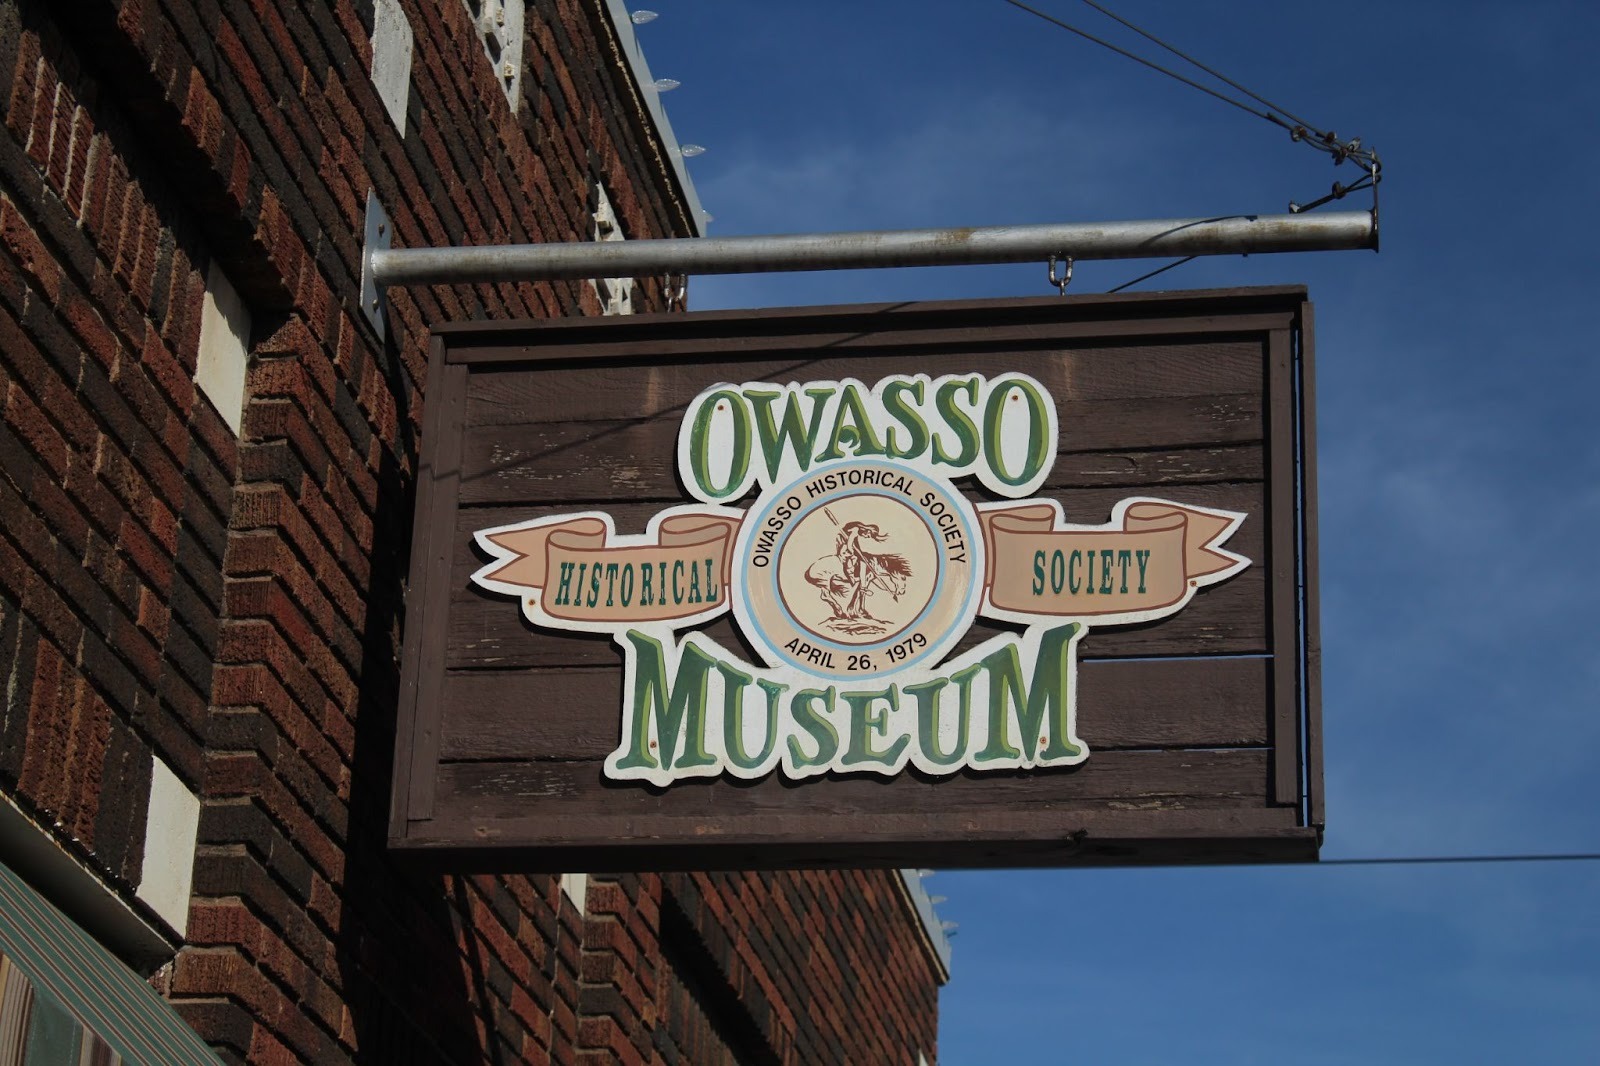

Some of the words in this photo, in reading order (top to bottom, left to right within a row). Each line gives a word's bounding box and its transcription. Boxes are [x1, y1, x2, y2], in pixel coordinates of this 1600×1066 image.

[689, 377, 1050, 499] OWASSO
[752, 496, 802, 568] OWASSO
[805, 469, 915, 498] HISTORICAL
[919, 492, 966, 564] SOCIETY
[554, 558, 719, 609] HISTORICAL
[1032, 549, 1151, 596] SOCIETY
[615, 621, 1082, 772] MUSEUM
[784, 637, 836, 669] APRIL
[847, 654, 878, 671] 26,
[885, 632, 928, 664] 1979
